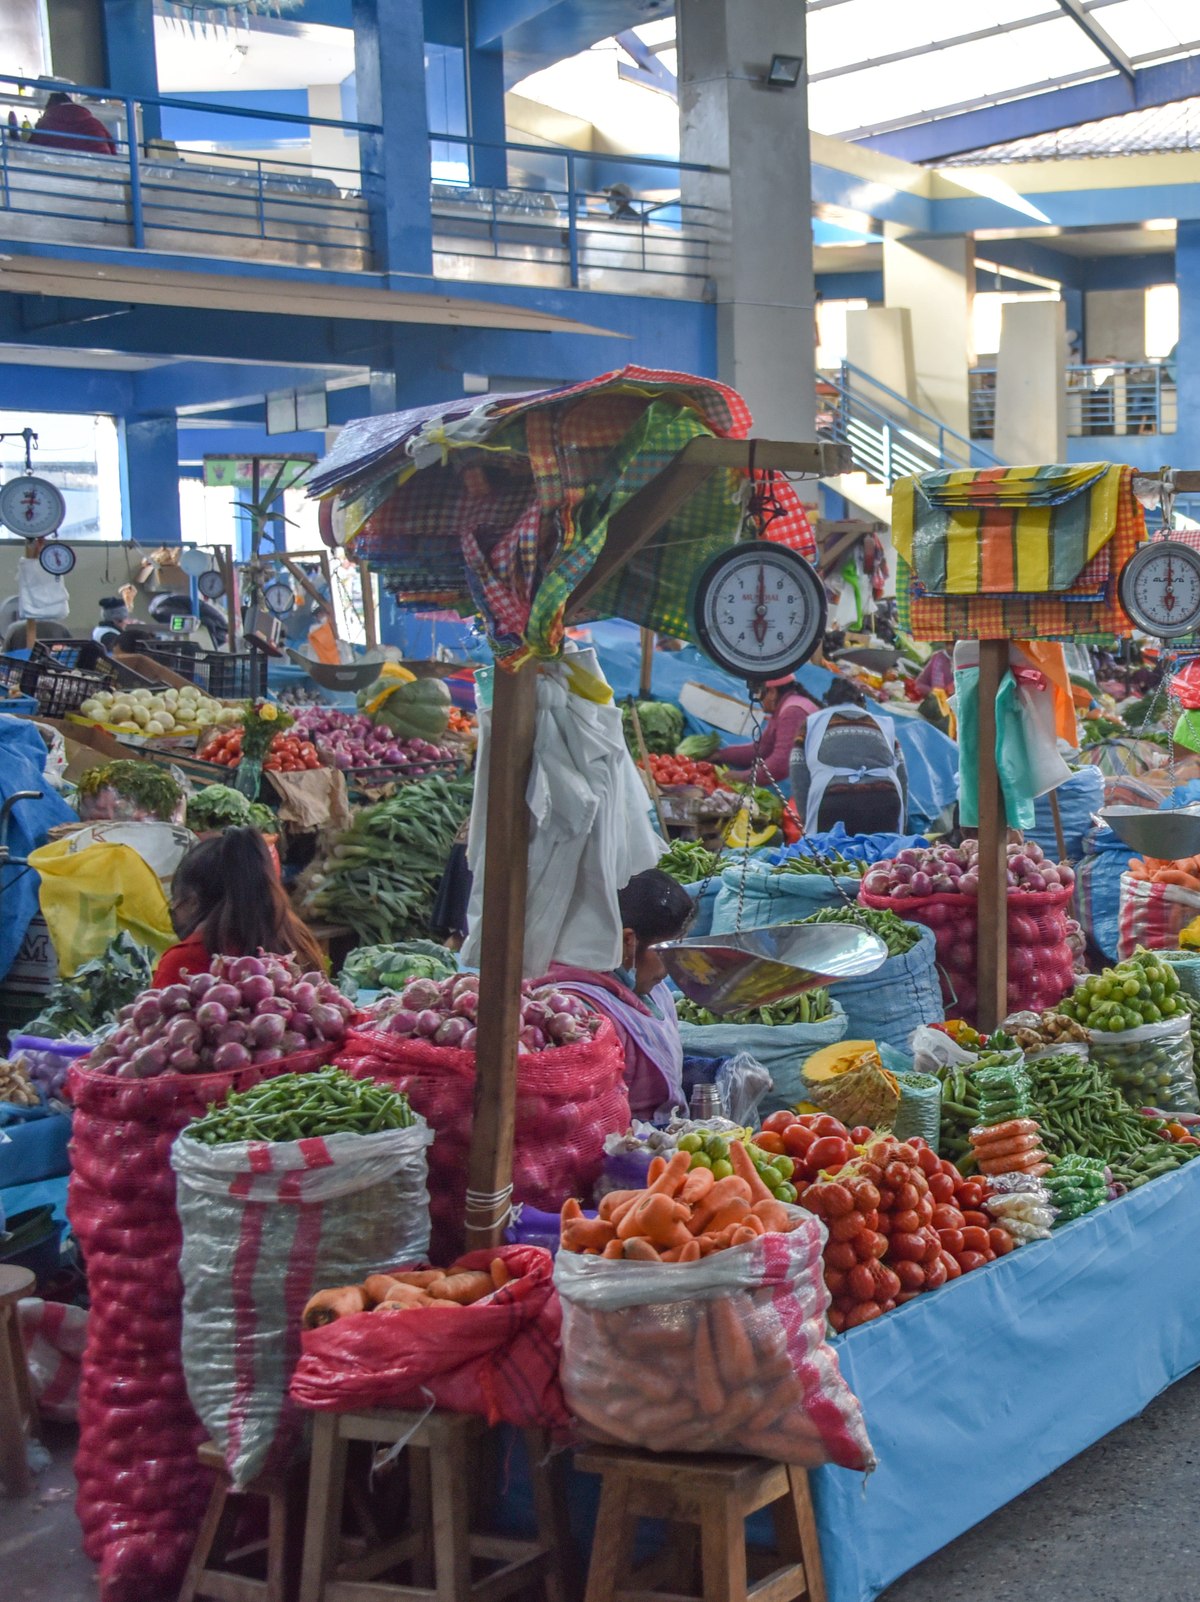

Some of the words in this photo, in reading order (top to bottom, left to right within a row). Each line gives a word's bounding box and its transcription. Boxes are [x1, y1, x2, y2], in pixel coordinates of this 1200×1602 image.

[776, 580, 784, 590] 9
[728, 594, 735, 604] 2
[787, 595, 794, 604] 8
[728, 616, 735, 625] 3
[789, 617, 795, 625] 7
[738, 631, 745, 641] 4
[776, 631, 784, 640] 6
